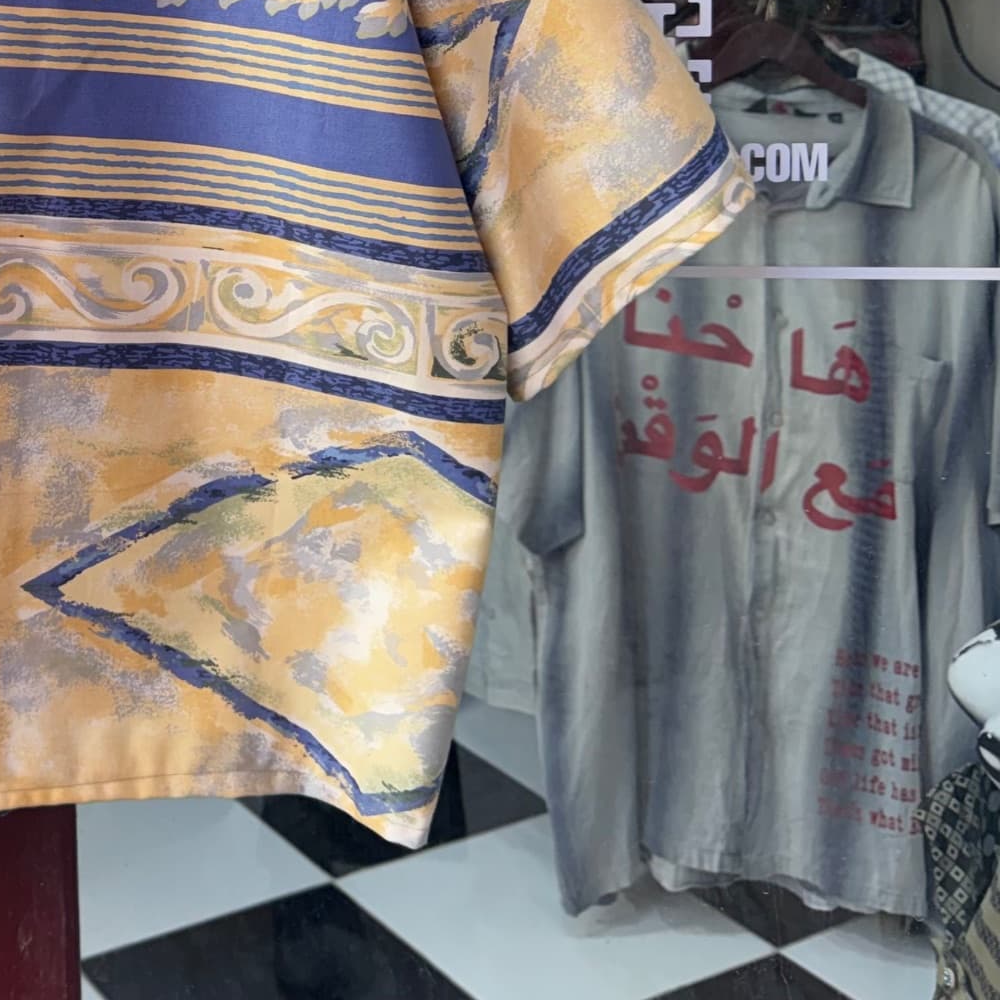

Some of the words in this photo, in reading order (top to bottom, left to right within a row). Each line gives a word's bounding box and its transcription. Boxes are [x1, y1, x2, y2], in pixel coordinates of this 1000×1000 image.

[893, 659, 920, 679] are
[869, 682, 901, 707] that
[867, 711, 898, 737] that
